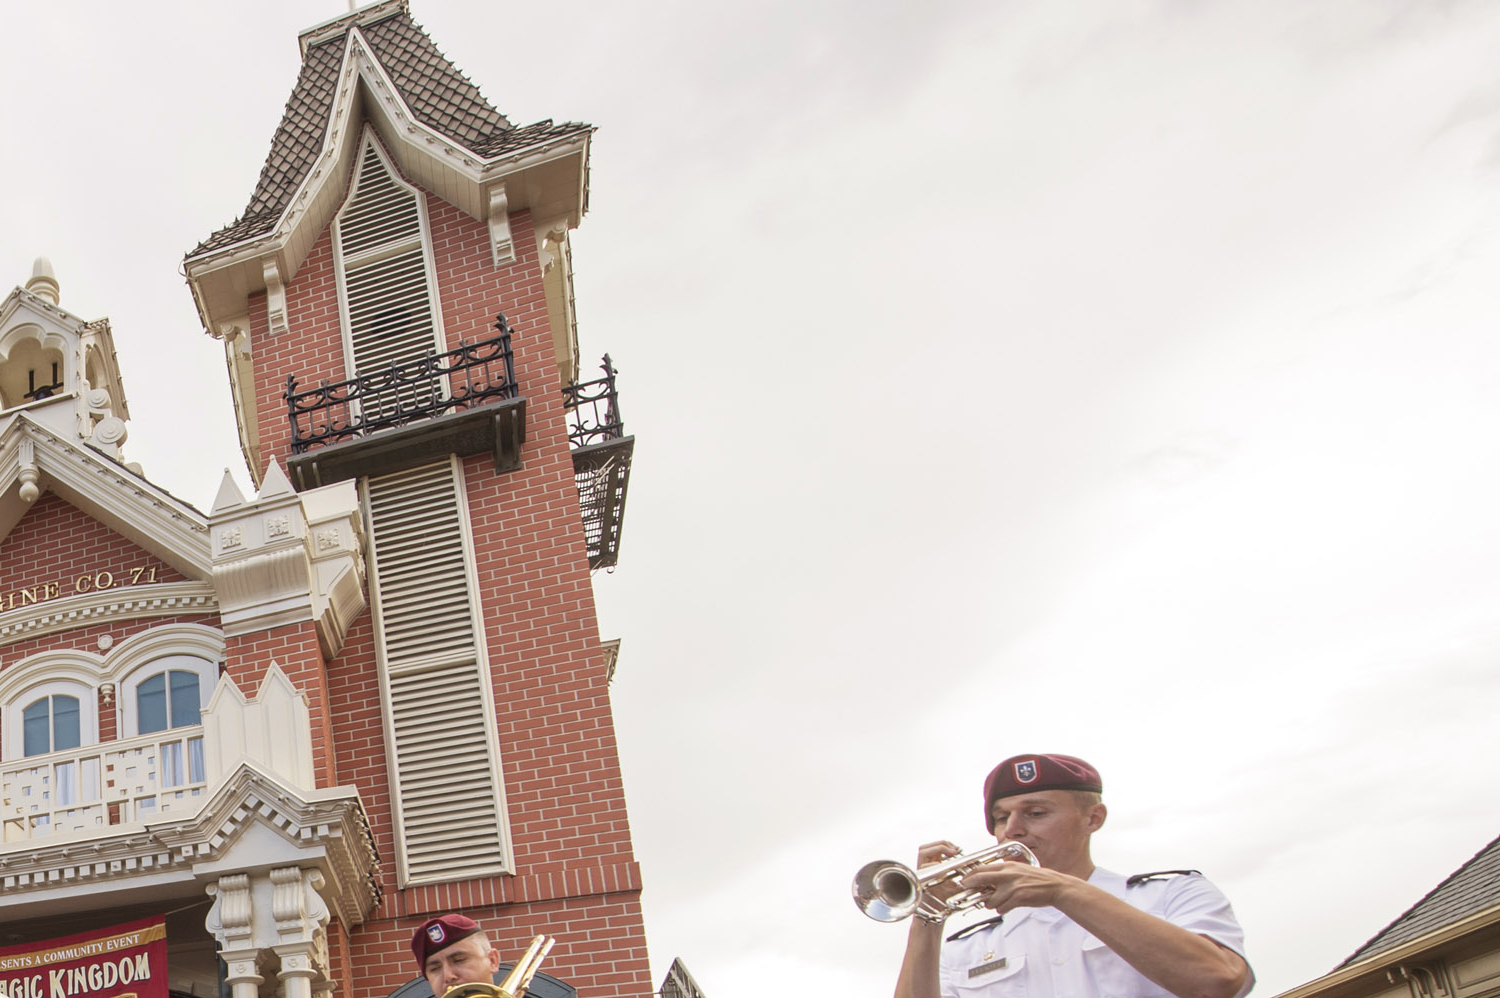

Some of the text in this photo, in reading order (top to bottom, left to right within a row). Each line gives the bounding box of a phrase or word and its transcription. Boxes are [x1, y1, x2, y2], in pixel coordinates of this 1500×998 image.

[76, 571, 117, 593] CO.
[129, 566, 157, 585] 71
[35, 955, 41, 965] A
[43, 943, 103, 962] COMMUNITY
[107, 934, 140, 951] EVENT
